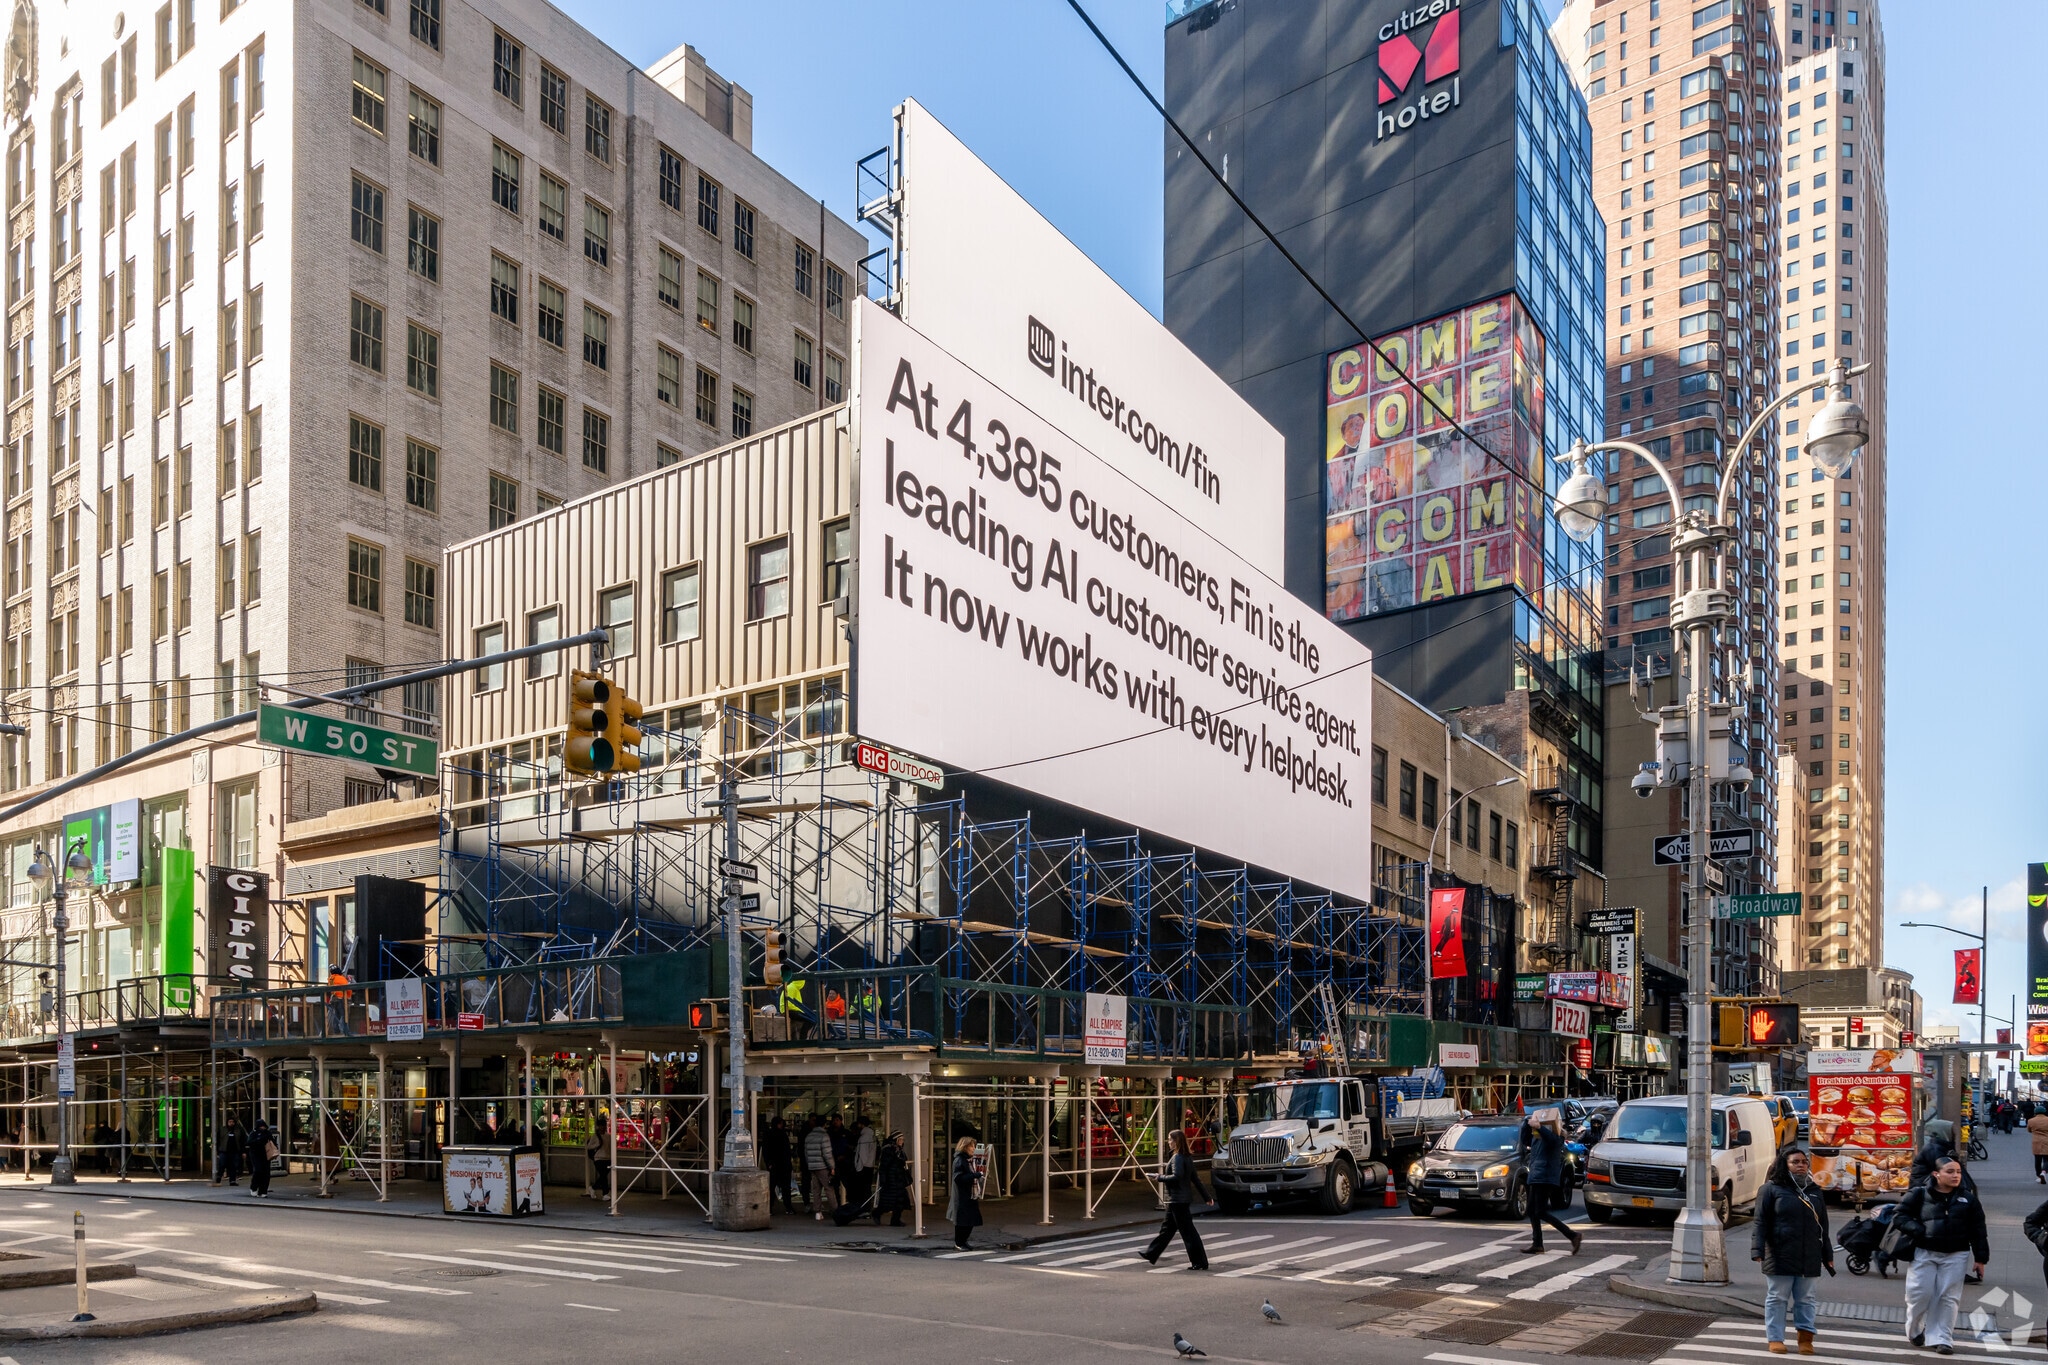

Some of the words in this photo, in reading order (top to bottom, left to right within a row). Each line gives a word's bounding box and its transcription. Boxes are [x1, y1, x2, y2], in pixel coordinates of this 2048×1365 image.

[1377, 76, 1460, 139] hotel
[1330, 303, 1501, 397] COME
[1375, 362, 1501, 440] ONE
[1061, 340, 1220, 505] inter.com/fin
[885, 356, 939, 441] At
[946, 398, 1062, 513] 4,385
[1069, 489, 1225, 626] customers,
[1230, 577, 1264, 641] Fin
[1268, 603, 1285, 653] is
[1287, 619, 1320, 675] the
[884, 437, 1034, 594] leading
[1040, 538, 1078, 604] AI
[1086, 577, 1219, 678] customer
[1221, 653, 1302, 724] service
[1305, 700, 1361, 758] agent.
[884, 533, 914, 609] It
[924, 572, 1011, 649] now
[1017, 617, 1119, 700] works
[1123, 669, 1186, 730] with
[1190, 703, 1258, 773] every
[1261, 722, 1352, 809] helpdesk.
[284, 716, 308, 743] W
[326, 725, 368, 755] 50
[381, 738, 418, 764] ST
[862, 747, 886, 770] BIG
[890, 758, 941, 784] OUTDOOR
[1667, 842, 1690, 856] ONE
[1710, 838, 1738, 852] WAY
[725, 864, 739, 874] ONE
[741, 867, 754, 877] WAY
[741, 899, 755, 908] WAY
[1731, 896, 1798, 914] Broadway
[226, 873, 257, 981] GIFTS
[1616, 936, 1630, 969] MIXED
[170, 986, 192, 1004] TD
[390, 1000, 400, 1010] ALL
[401, 999, 420, 1010] EMPIRE
[1554, 1005, 1586, 1035] PIZZA
[2027, 1004, 2048, 1014] Wic
[389, 1025, 422, 1035] 212-920-4870
[1089, 1017, 1100, 1029] ALL
[1100, 1018, 1123, 1031] EMPIRE
[1087, 1046, 1124, 1058] 212-920-4870
[1817, 1077, 1854, 1085] Breakfast
[1862, 1076, 1900, 1085] Sandwich
[449, 1170, 484, 1179] MISSIONARY
[484, 1171, 503, 1180] STYLE
